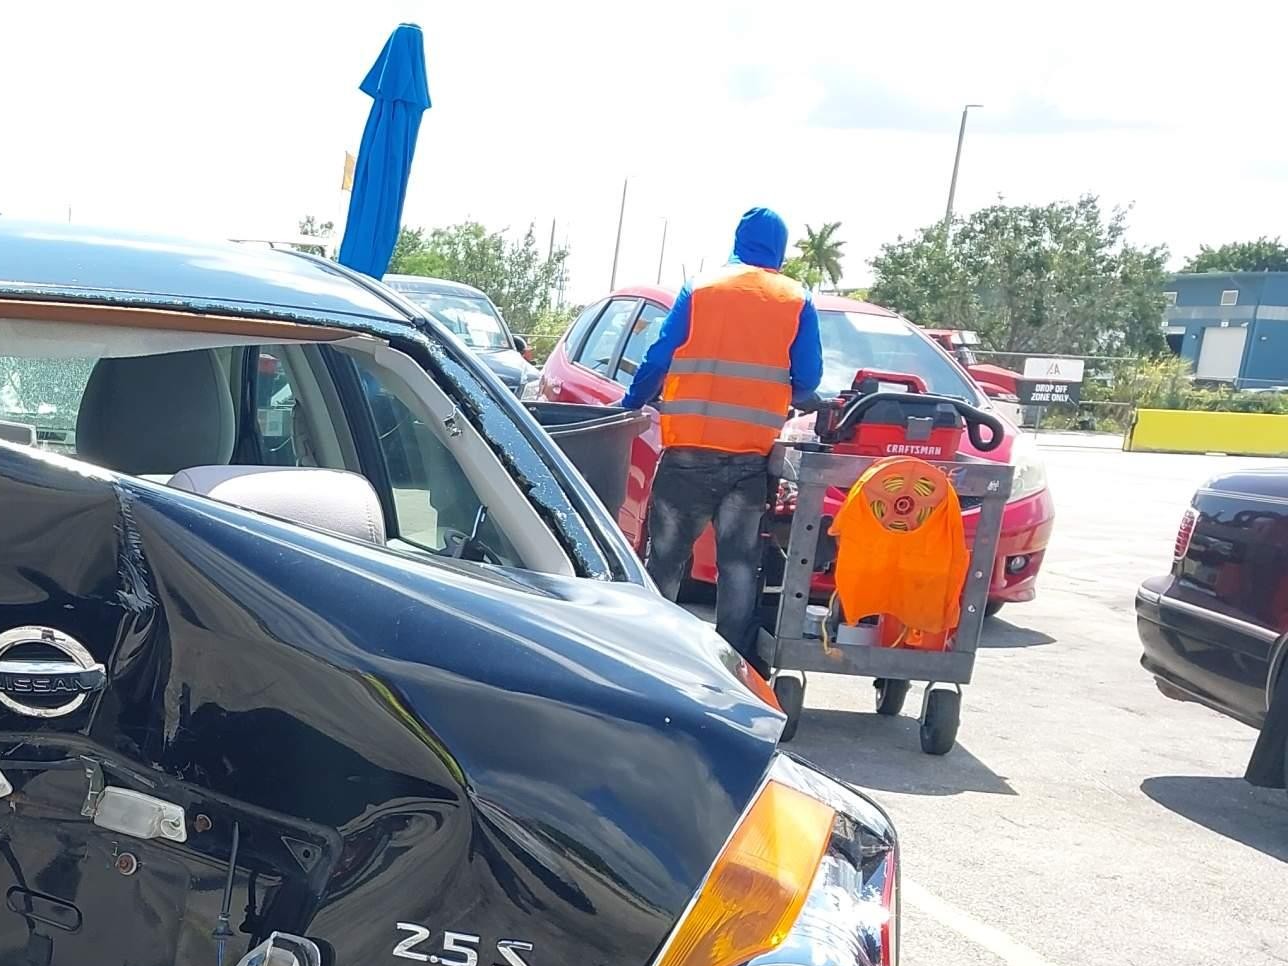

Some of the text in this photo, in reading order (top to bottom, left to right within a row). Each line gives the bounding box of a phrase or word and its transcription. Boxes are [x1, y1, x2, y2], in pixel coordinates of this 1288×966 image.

[1035, 383, 1068, 394] DROP OFF
[1030, 392, 1070, 402] ZONE ONLY
[886, 443, 942, 456] CRAFTSMAN
